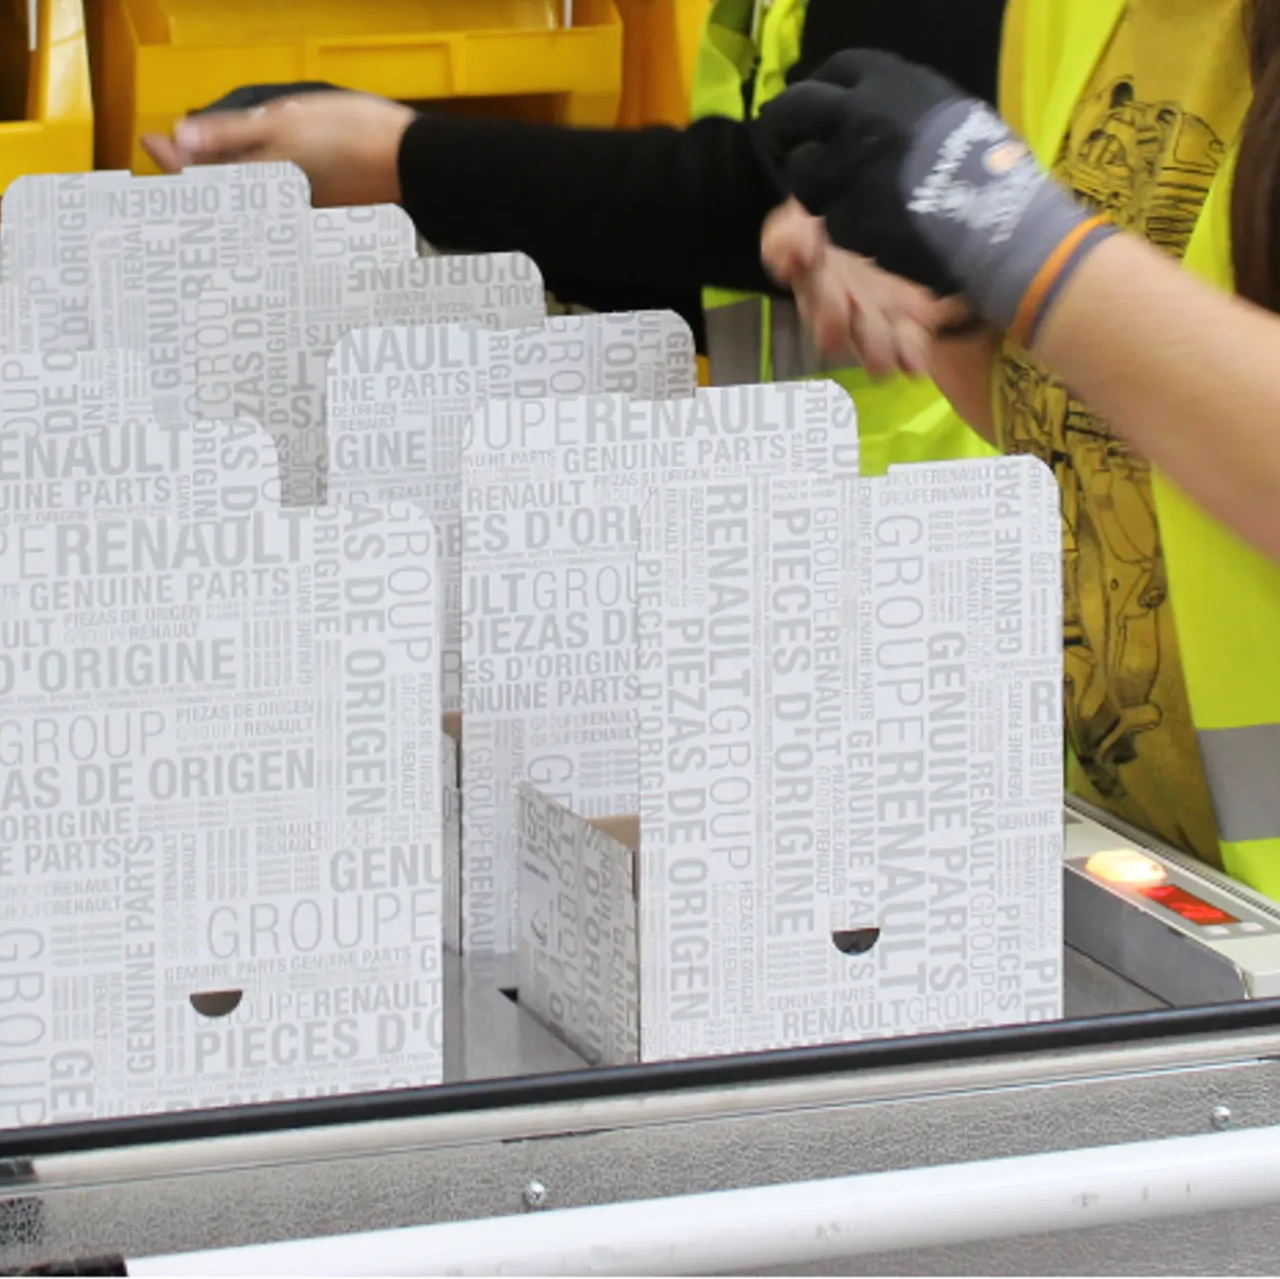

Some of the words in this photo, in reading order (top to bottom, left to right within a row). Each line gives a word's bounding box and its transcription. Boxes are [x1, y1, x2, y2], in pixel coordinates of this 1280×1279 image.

[109, 184, 220, 219] ORIGEN
[230, 182, 267, 212] DE
[146, 239, 180, 390] GENUINE
[231, 295, 263, 340] DE
[233, 351, 265, 418] ZAS
[267, 295, 290, 423] D'ORIGINE
[387, 371, 469, 398] PARTS
[42, 384, 78, 434] DE
[563, 440, 685, 473] GENUINE
[697, 433, 788, 464] PARTS
[75, 473, 171, 506] PARTS
[466, 479, 585, 512] RENAULT
[29, 576, 174, 612] GENUINE
[187, 567, 292, 602] PARTS
[344, 577, 385, 635] DE
[637, 560, 662, 670] PIECES
[771, 508, 812, 676] PIECES
[994, 525, 1022, 655] GENUINE
[557, 674, 640, 707] PARTS
[666, 616, 709, 773] PIEZAS
[345, 649, 387, 818] ORIGEN
[927, 630, 968, 832] GENUINE
[76, 759, 134, 806] DE
[148, 748, 315, 800] ORIGEN
[772, 691, 816, 935] D'ORIGINE
[846, 729, 875, 869] GENUINE
[669, 787, 708, 843] DE
[24, 836, 122, 873] PARTS
[124, 835, 155, 936] PARTS
[207, 888, 437, 960] GROUPE
[667, 858, 711, 1022] ORIGEN
[846, 880, 875, 982] PAS
[927, 847, 969, 993] PARTS
[997, 904, 1021, 1012] PIECES
[126, 941, 155, 1074] GENUINE
[194, 1012, 360, 1073] PIECES
[49, 1049, 94, 1121] GE
